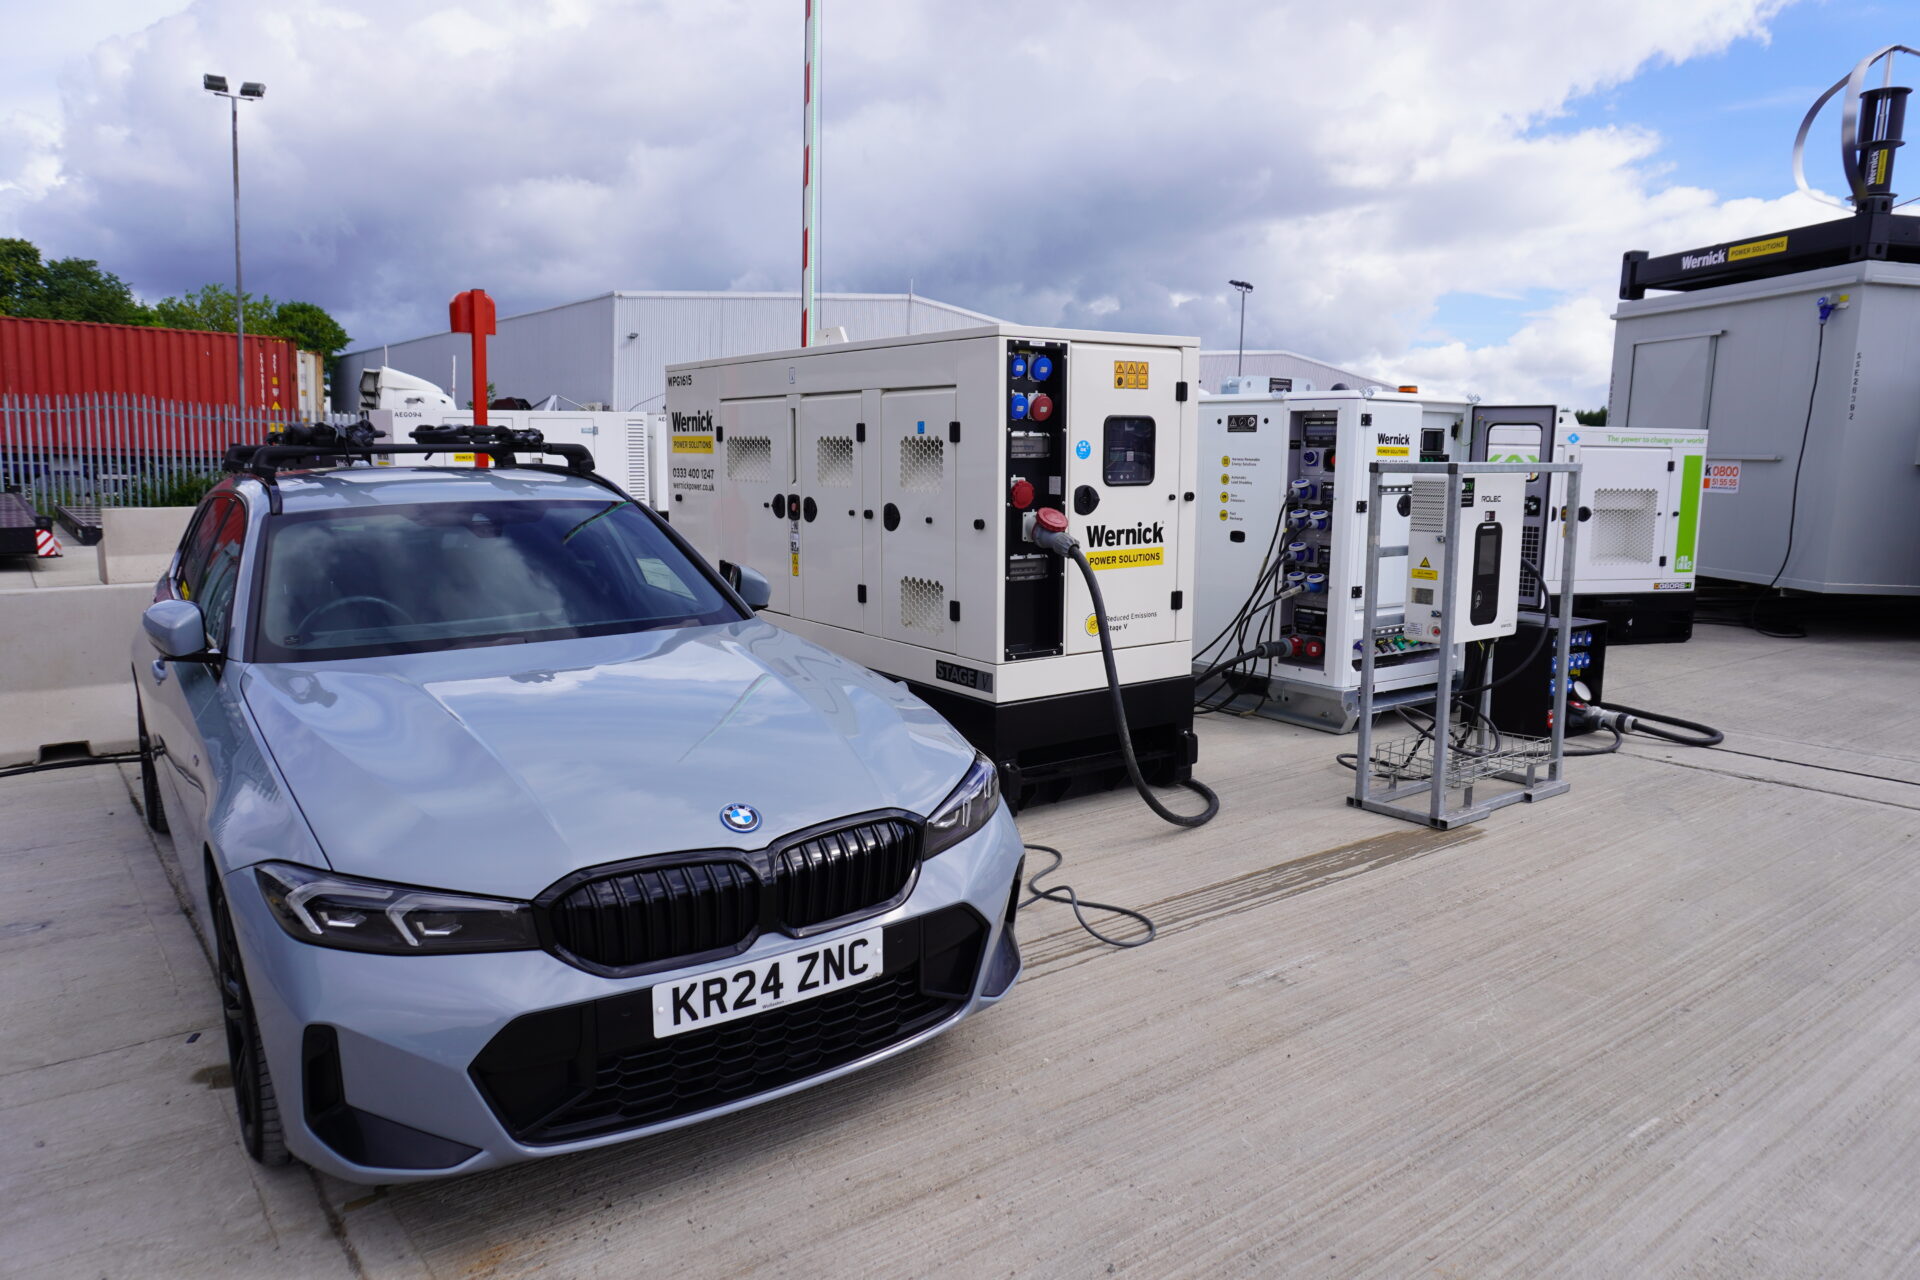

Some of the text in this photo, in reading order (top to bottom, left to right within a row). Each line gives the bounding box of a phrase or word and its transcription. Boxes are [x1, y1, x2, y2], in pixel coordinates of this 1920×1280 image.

[1682, 248, 1726, 270] Wernick
[667, 375, 693, 387] WPG1615
[672, 410, 713, 433] Wernick
[688, 441, 712, 449] SOLUTIONS
[1377, 433, 1410, 445] Wernick
[672, 468, 714, 479] 0333 400 1247
[1712, 466, 1739, 477] 0800
[672, 482, 715, 492] wernickpower.co.uk
[1086, 521, 1164, 548] Wernick
[1089, 552, 1161, 566] POWER SOLUTIONS
[1130, 611, 1157, 620] Emissions
[937, 662, 975, 686] STAGE
[671, 938, 869, 1026] KR24 ZNC
